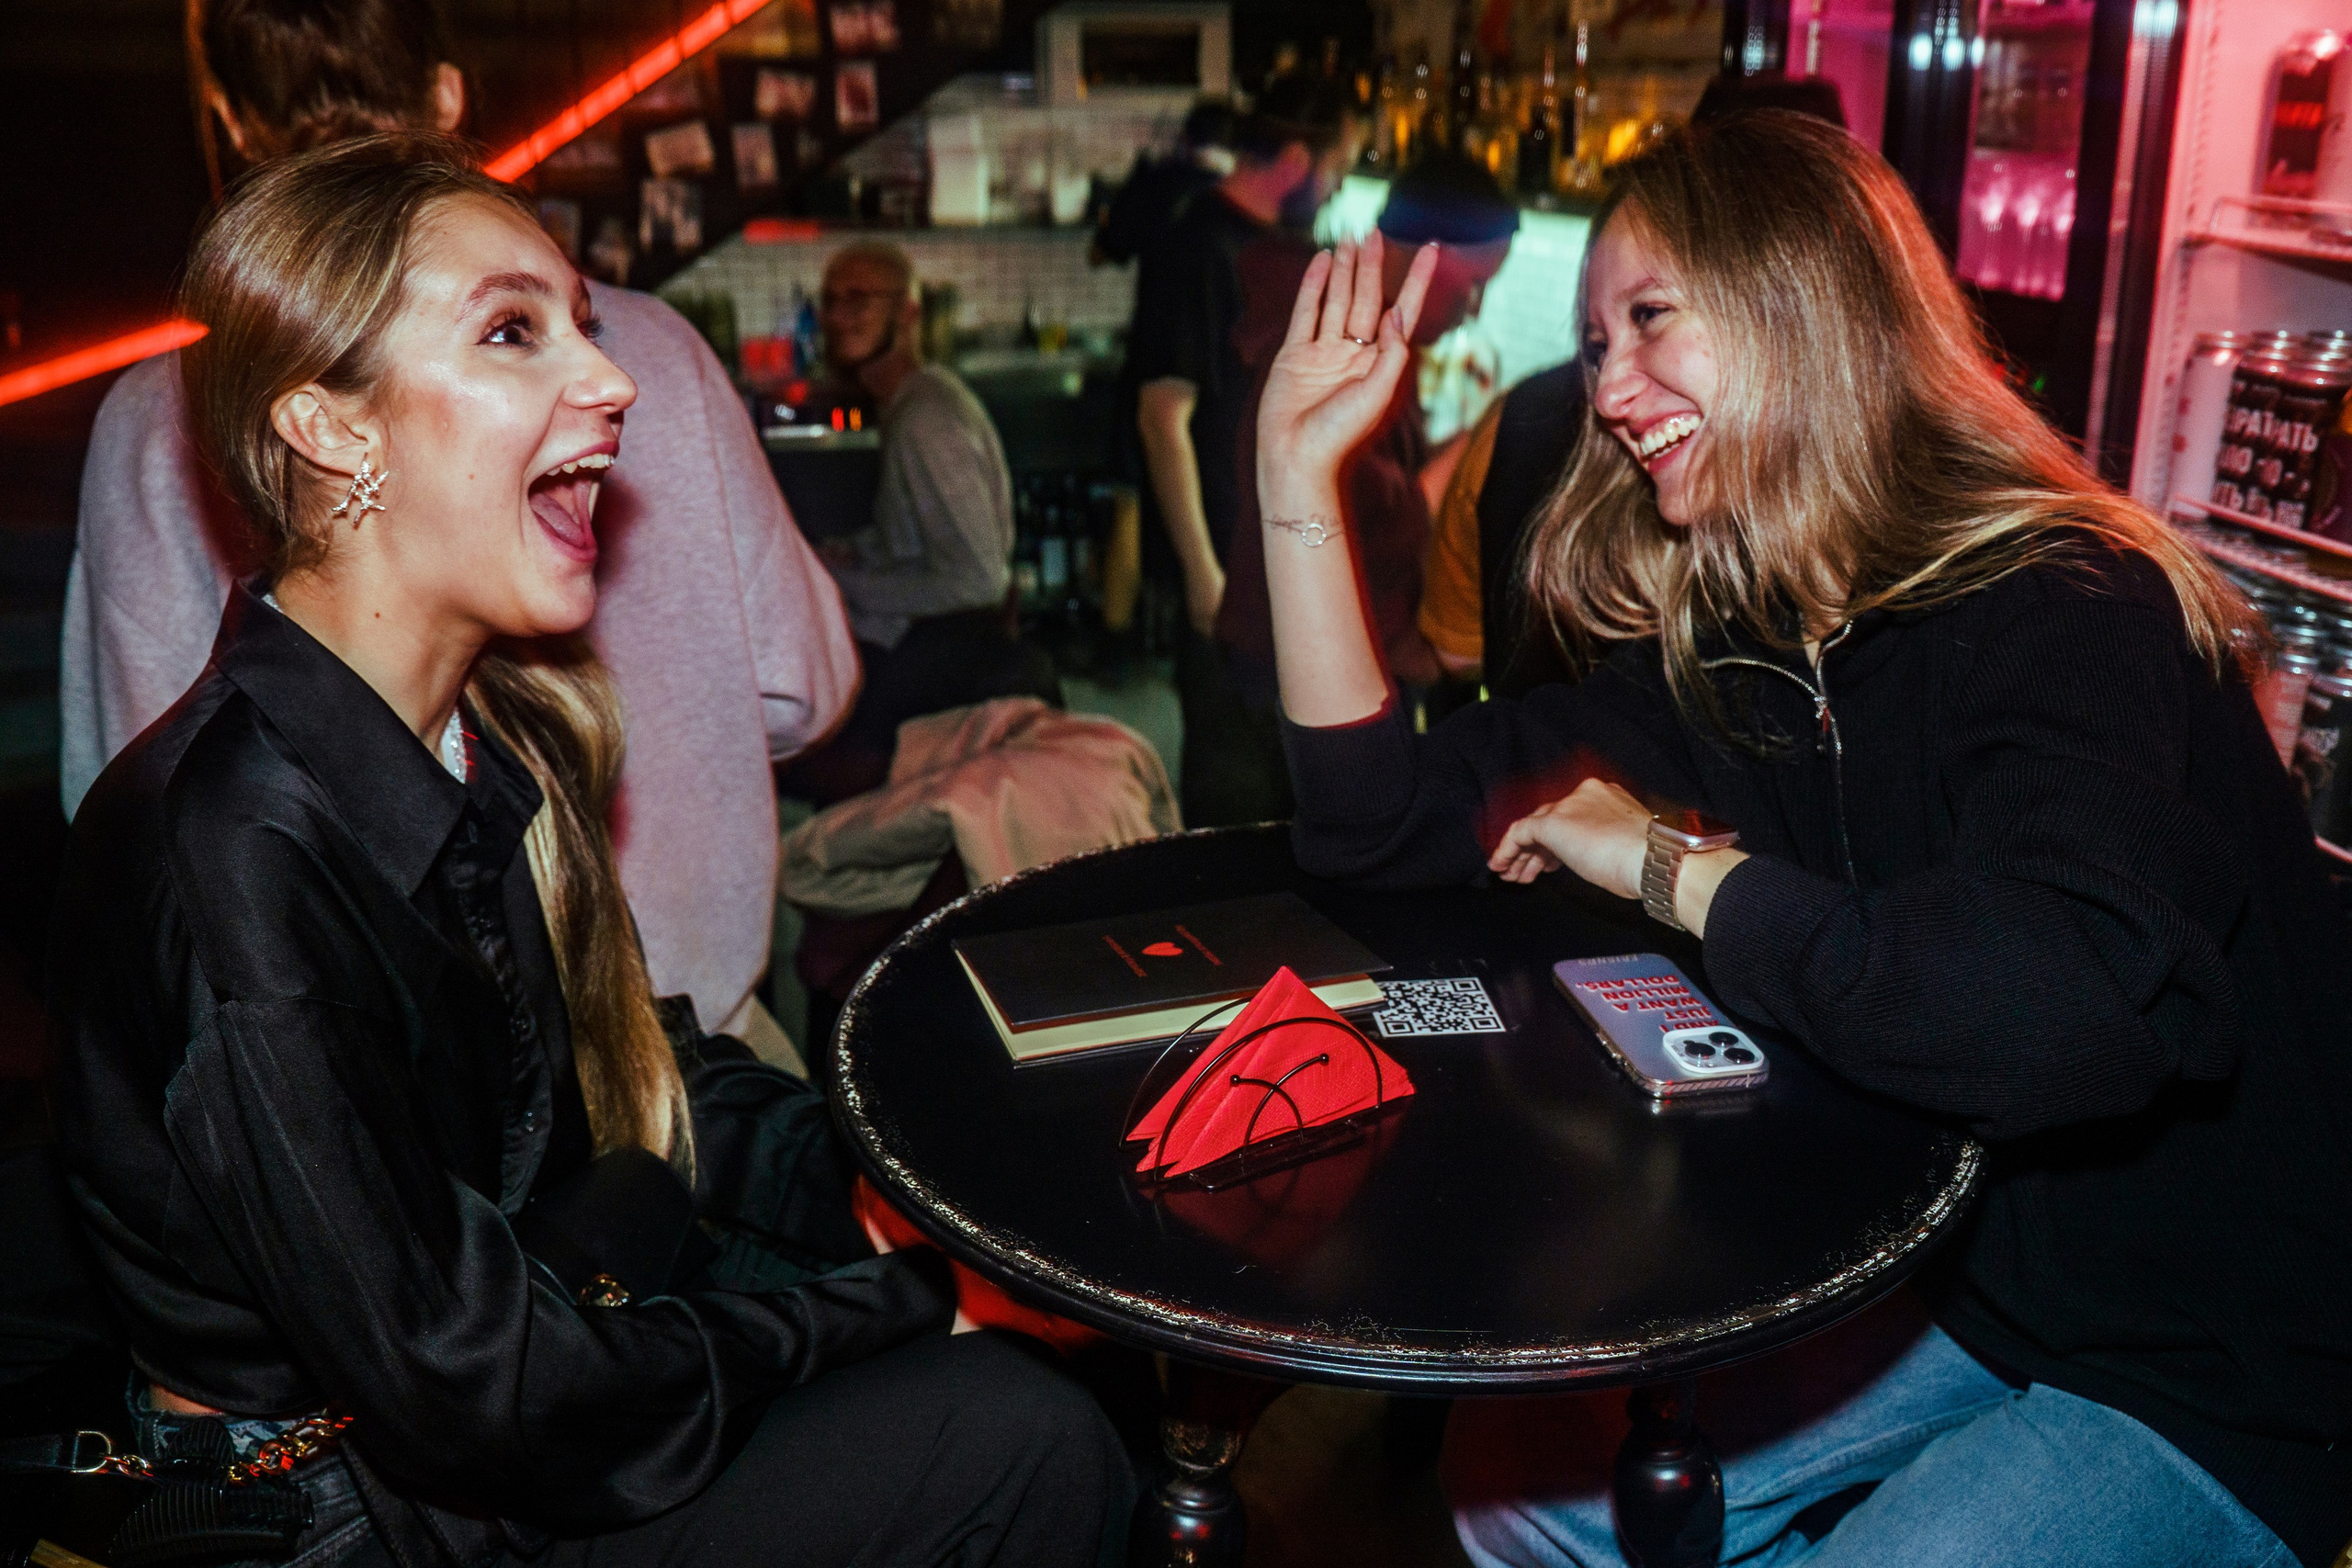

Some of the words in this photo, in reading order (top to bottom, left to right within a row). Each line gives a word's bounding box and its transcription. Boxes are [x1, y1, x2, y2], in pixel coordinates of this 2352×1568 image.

[1601, 986, 1690, 1002] MILLION
[1612, 1001, 1630, 1013] A
[1636, 996, 1702, 1011] WANT
[1664, 1006, 1713, 1021] JUST
[1673, 1021, 1720, 1031] AND
